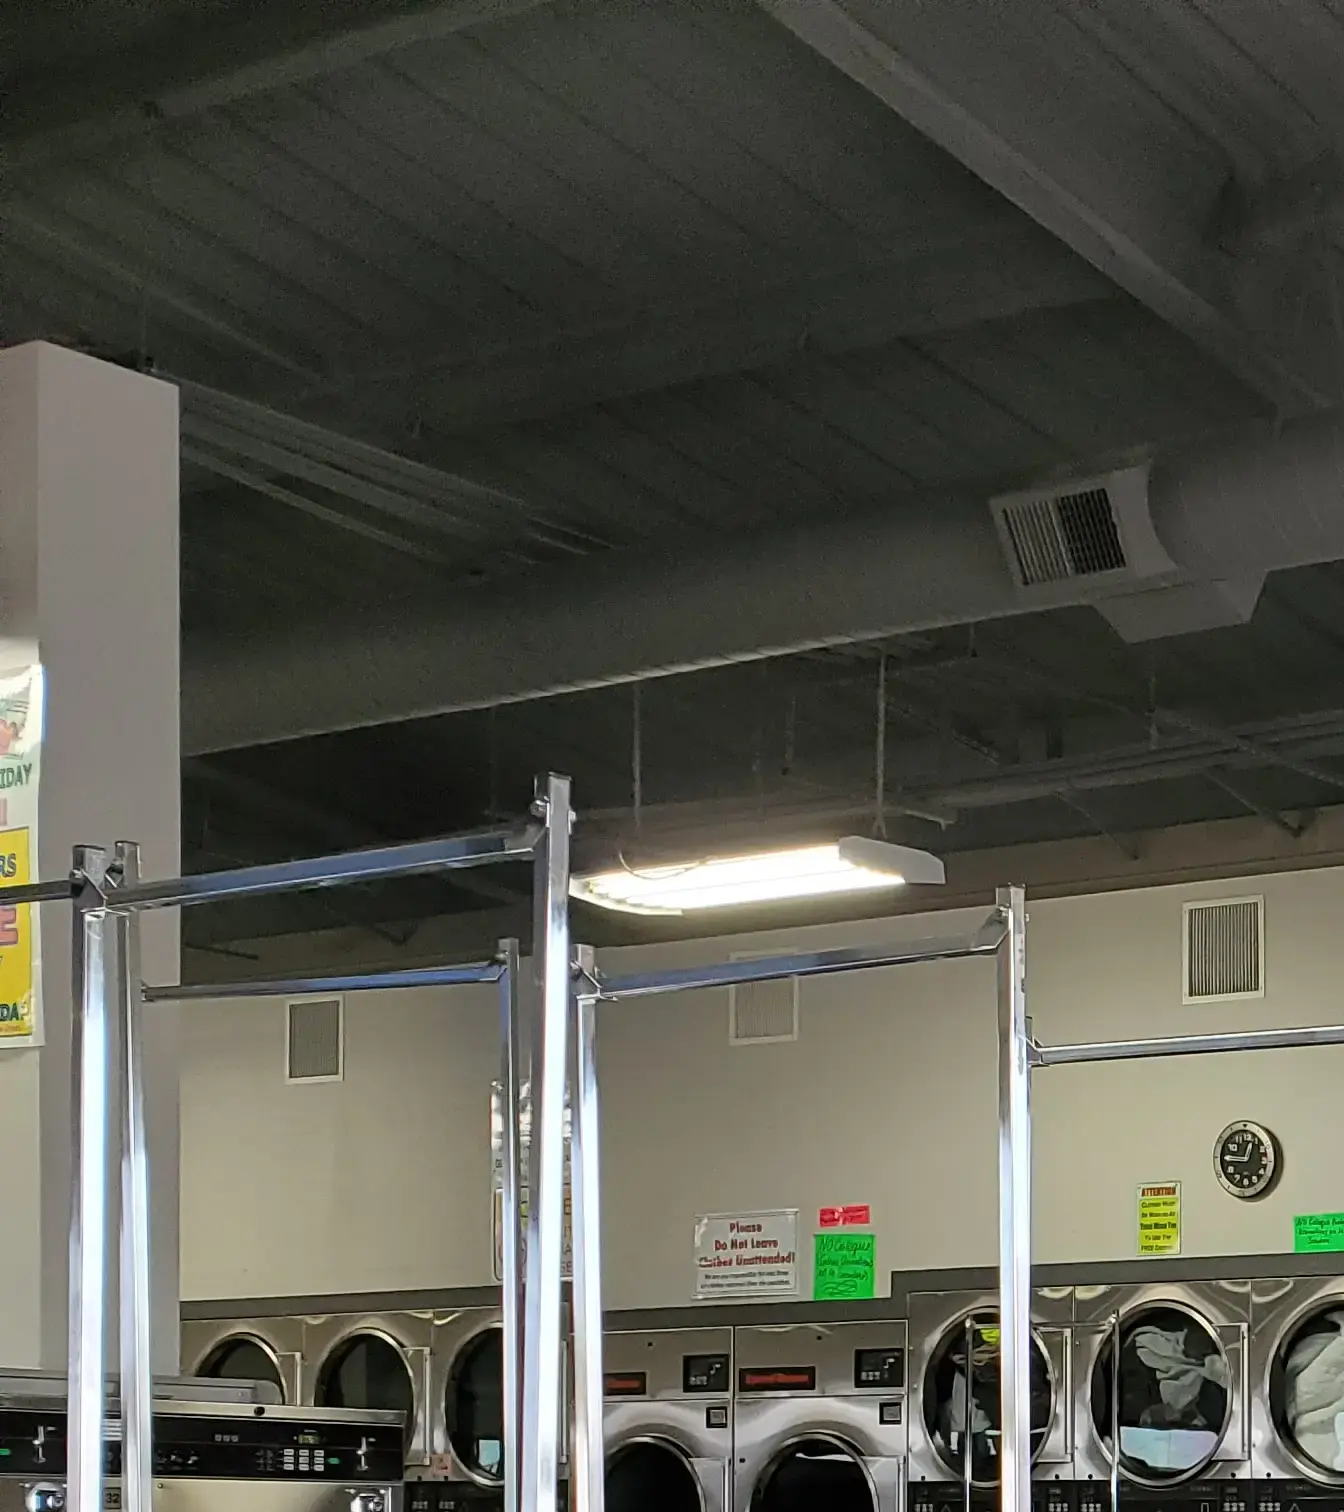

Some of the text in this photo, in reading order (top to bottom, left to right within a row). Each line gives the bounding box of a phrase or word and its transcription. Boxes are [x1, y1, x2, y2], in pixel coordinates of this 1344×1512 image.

[729, 1220, 763, 1233] Please
[714, 1237, 779, 1251] Do Not Leave
